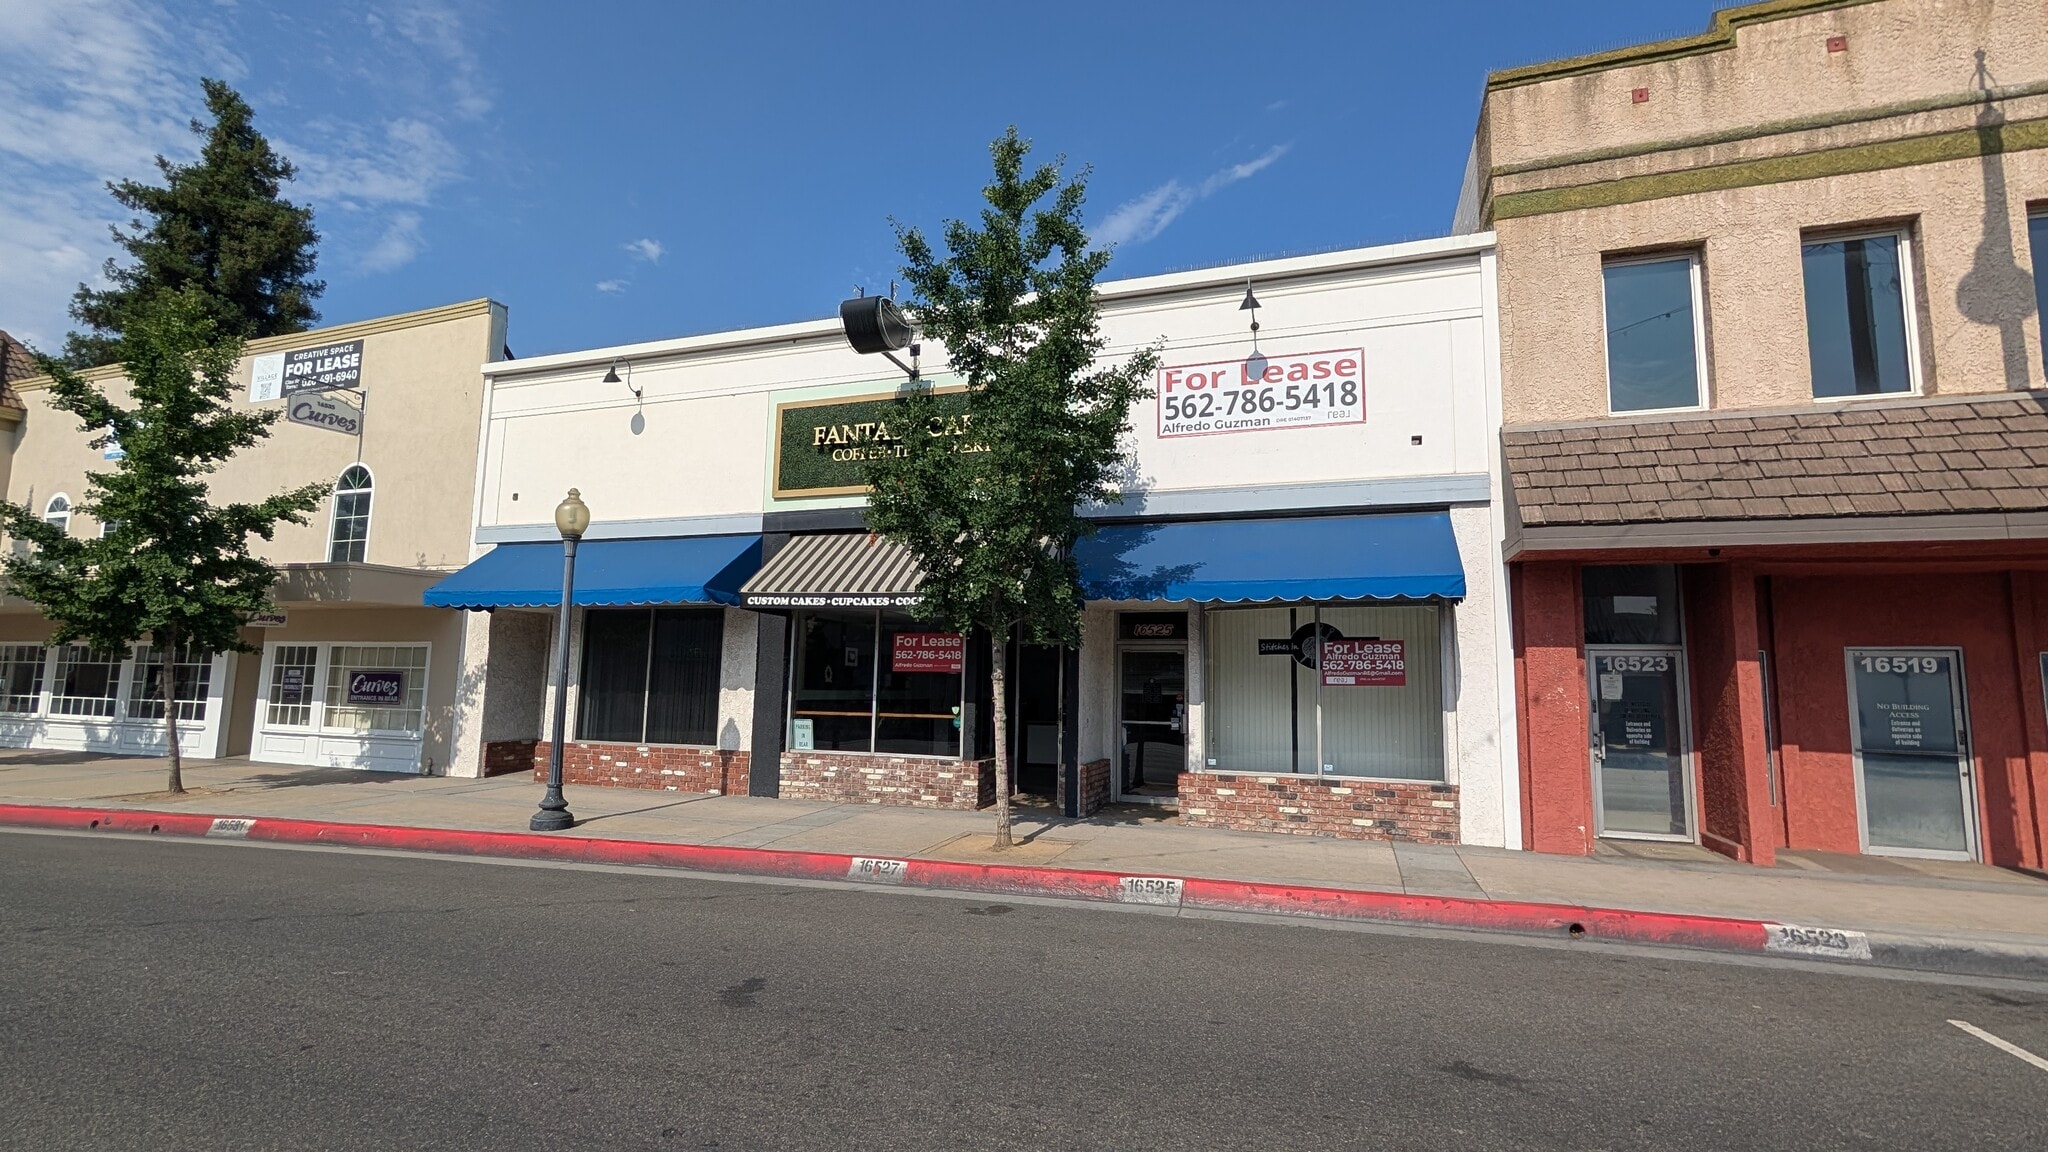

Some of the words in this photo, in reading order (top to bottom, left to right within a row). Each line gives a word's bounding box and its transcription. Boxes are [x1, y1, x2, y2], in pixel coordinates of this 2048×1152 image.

[294, 349, 328, 360] CREATIVE
[330, 344, 354, 355] SPACE
[286, 361, 312, 378] FOR
[316, 353, 360, 372] LEASE
[320, 370, 358, 384] 491-6940
[1166, 370, 1226, 393] For
[1241, 358, 1357, 386] Lease
[1165, 380, 1358, 420] 562-786-5418
[292, 402, 356, 431] Curves
[812, 420, 903, 446] FANTA
[1162, 421, 1210, 434] Alfredo
[1214, 418, 1270, 430] Guzman
[747, 597, 789, 605] CUSTOM
[790, 597, 826, 606] CAKES
[831, 597, 890, 606] CUPCAKES
[1134, 624, 1174, 636] 16525
[896, 636, 918, 646] For
[922, 636, 960, 646] Lease
[1324, 642, 1350, 654] For
[1355, 642, 1402, 654] Lease
[896, 650, 962, 660] 562-786-5418
[1322, 660, 1404, 670] 562-786-5418
[1603, 656, 1668, 672] 16523
[1861, 658, 1938, 673] 16519
[352, 674, 398, 696] Curves
[860, 860, 900, 875] 16527
[1128, 879, 1175, 895] 16525
[1780, 928, 1849, 950] 16523
